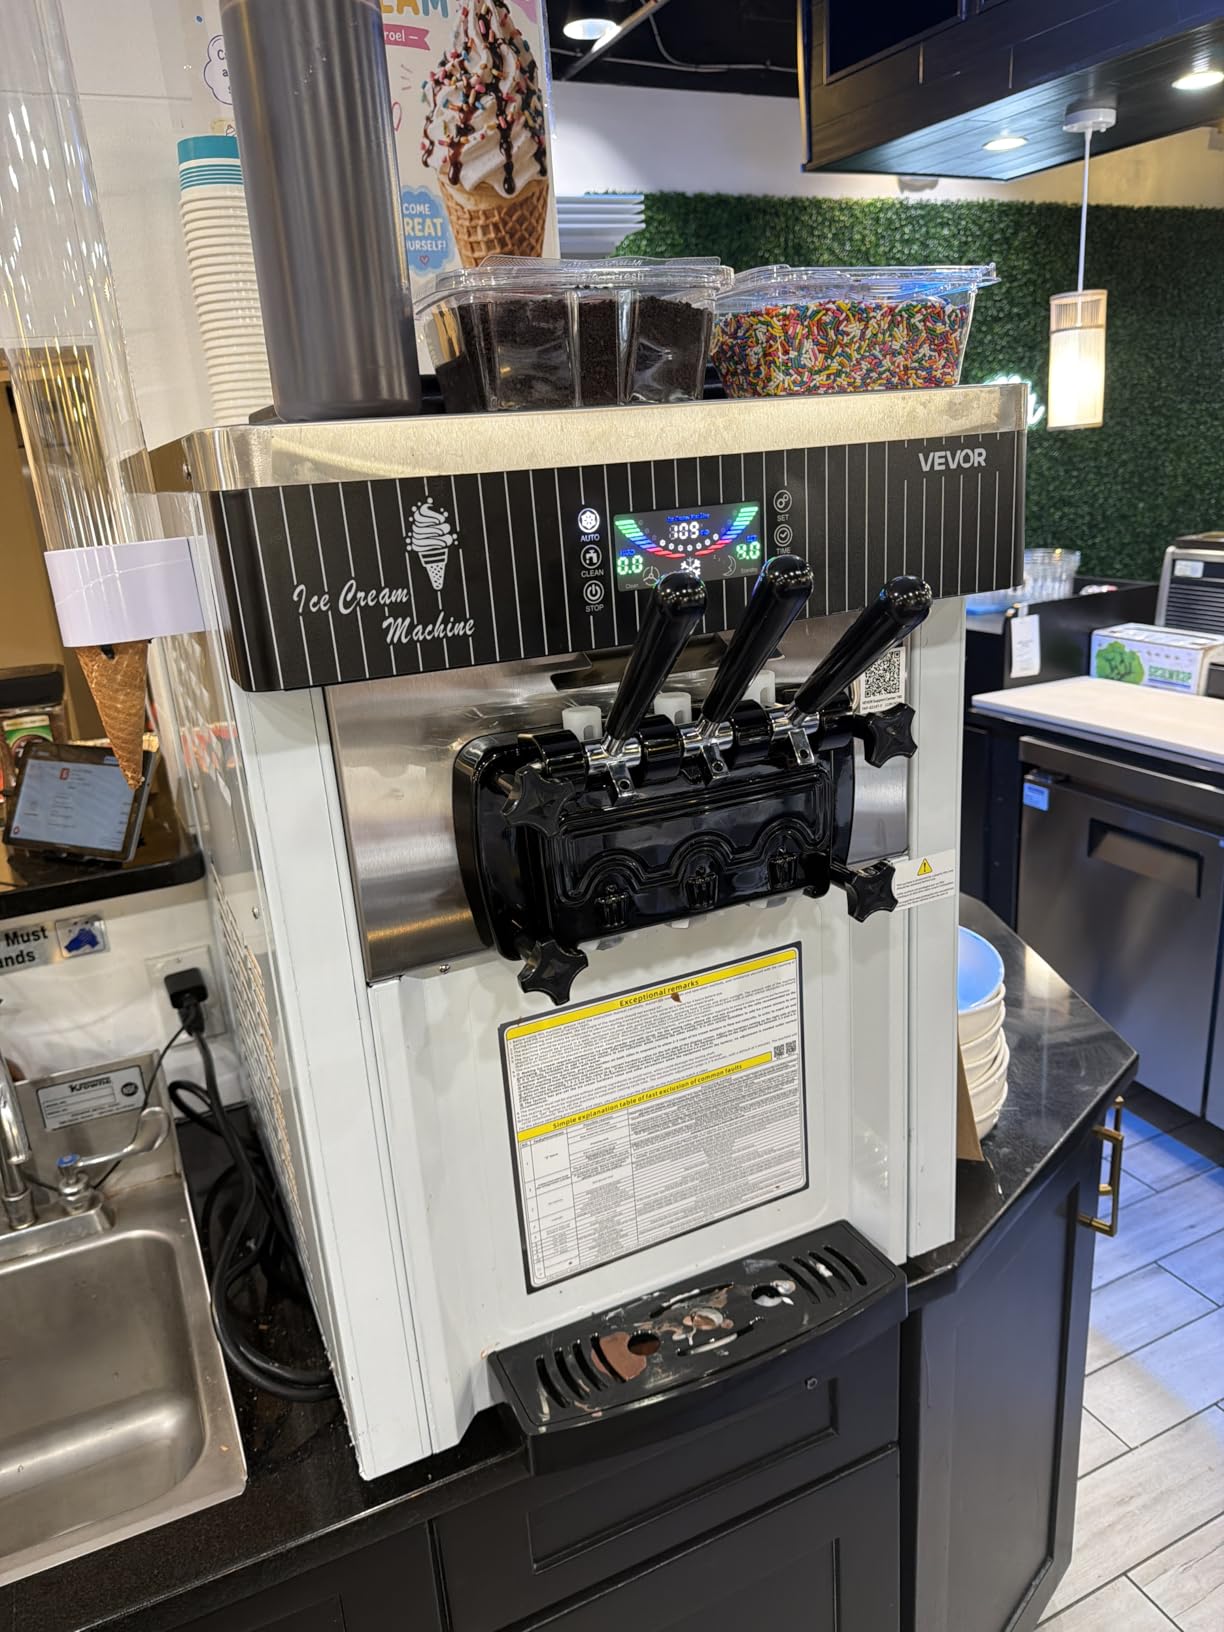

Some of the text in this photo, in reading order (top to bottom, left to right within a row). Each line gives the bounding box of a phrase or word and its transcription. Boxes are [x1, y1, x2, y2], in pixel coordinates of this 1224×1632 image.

[402, 203, 431, 215] COME
[404, 217, 443, 237] REAT
[406, 240, 446, 251] URSELF!
[918, 448, 987, 472] VEVOR
[776, 514, 790, 522] SET
[580, 534, 600, 542] AUTO
[581, 569, 604, 578] CLEAN
[292, 579, 409, 615] Ice Cream
[585, 604, 604, 613] STOP
[382, 611, 475, 645] Machine
[4, 925, 49, 947] Must
[619, 979, 699, 1008] Exceptional remarks
[552, 1117, 577, 1129] Simple
[578, 1104, 619, 1121] explanation
[619, 1097, 637, 1108] table
[645, 1090, 658, 1100] fast
[659, 1081, 690, 1095] exclusion
[697, 1071, 725, 1083] common
[725, 1064, 743, 1075] faults
